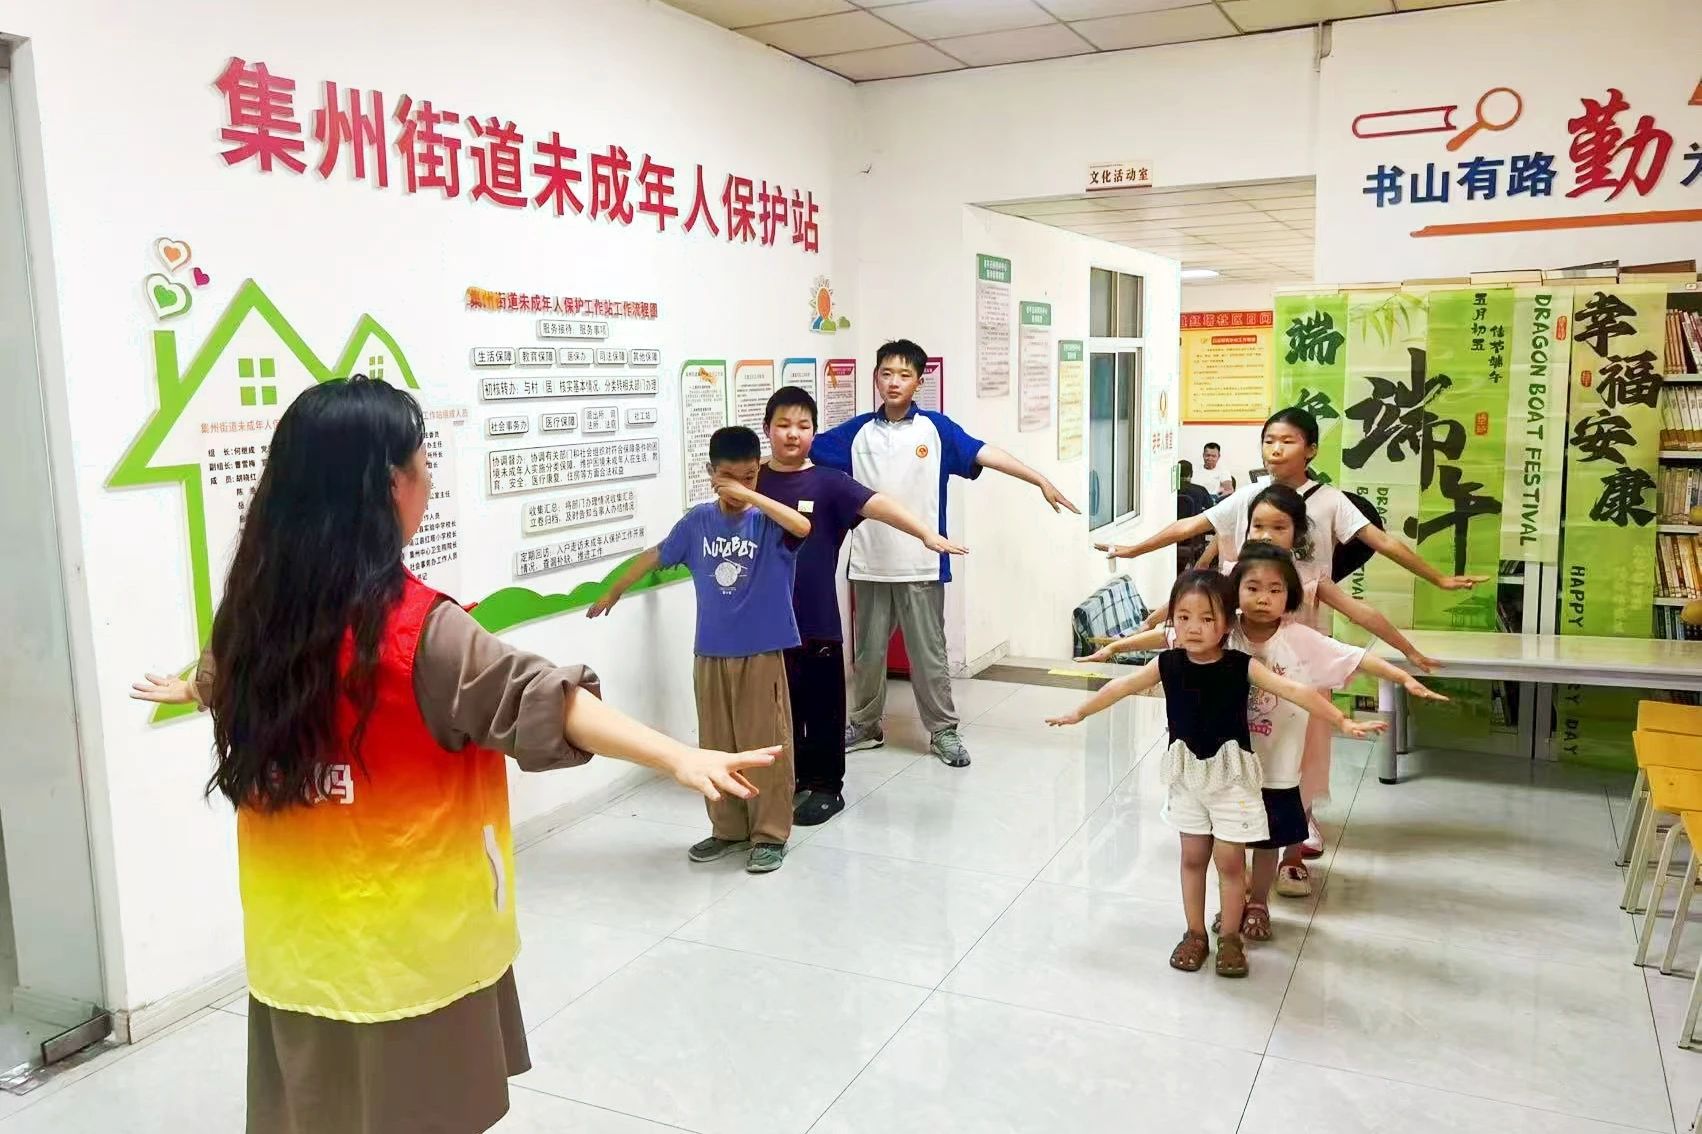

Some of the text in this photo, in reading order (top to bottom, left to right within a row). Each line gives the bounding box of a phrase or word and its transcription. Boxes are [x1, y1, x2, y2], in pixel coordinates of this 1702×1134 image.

[213, 56, 820, 253] 集州街道未成年人保护站
[1089, 167, 1149, 184] 文化活动室
[1471, 293, 1487, 351] 五月初五
[478, 350, 512, 362] 生活保障
[522, 351, 553, 362] 教育保障
[491, 421, 527, 432] 社会事务办
[545, 416, 575, 428] 医疗保障
[1519, 295, 1552, 547] DRAGON BOAT FESTIVAL
[1569, 291, 1663, 528] 幸福安康
[1342, 347, 1503, 580] 端午
[1568, 566, 1586, 628] HAPPY
[1564, 718, 1579, 755] DAY
